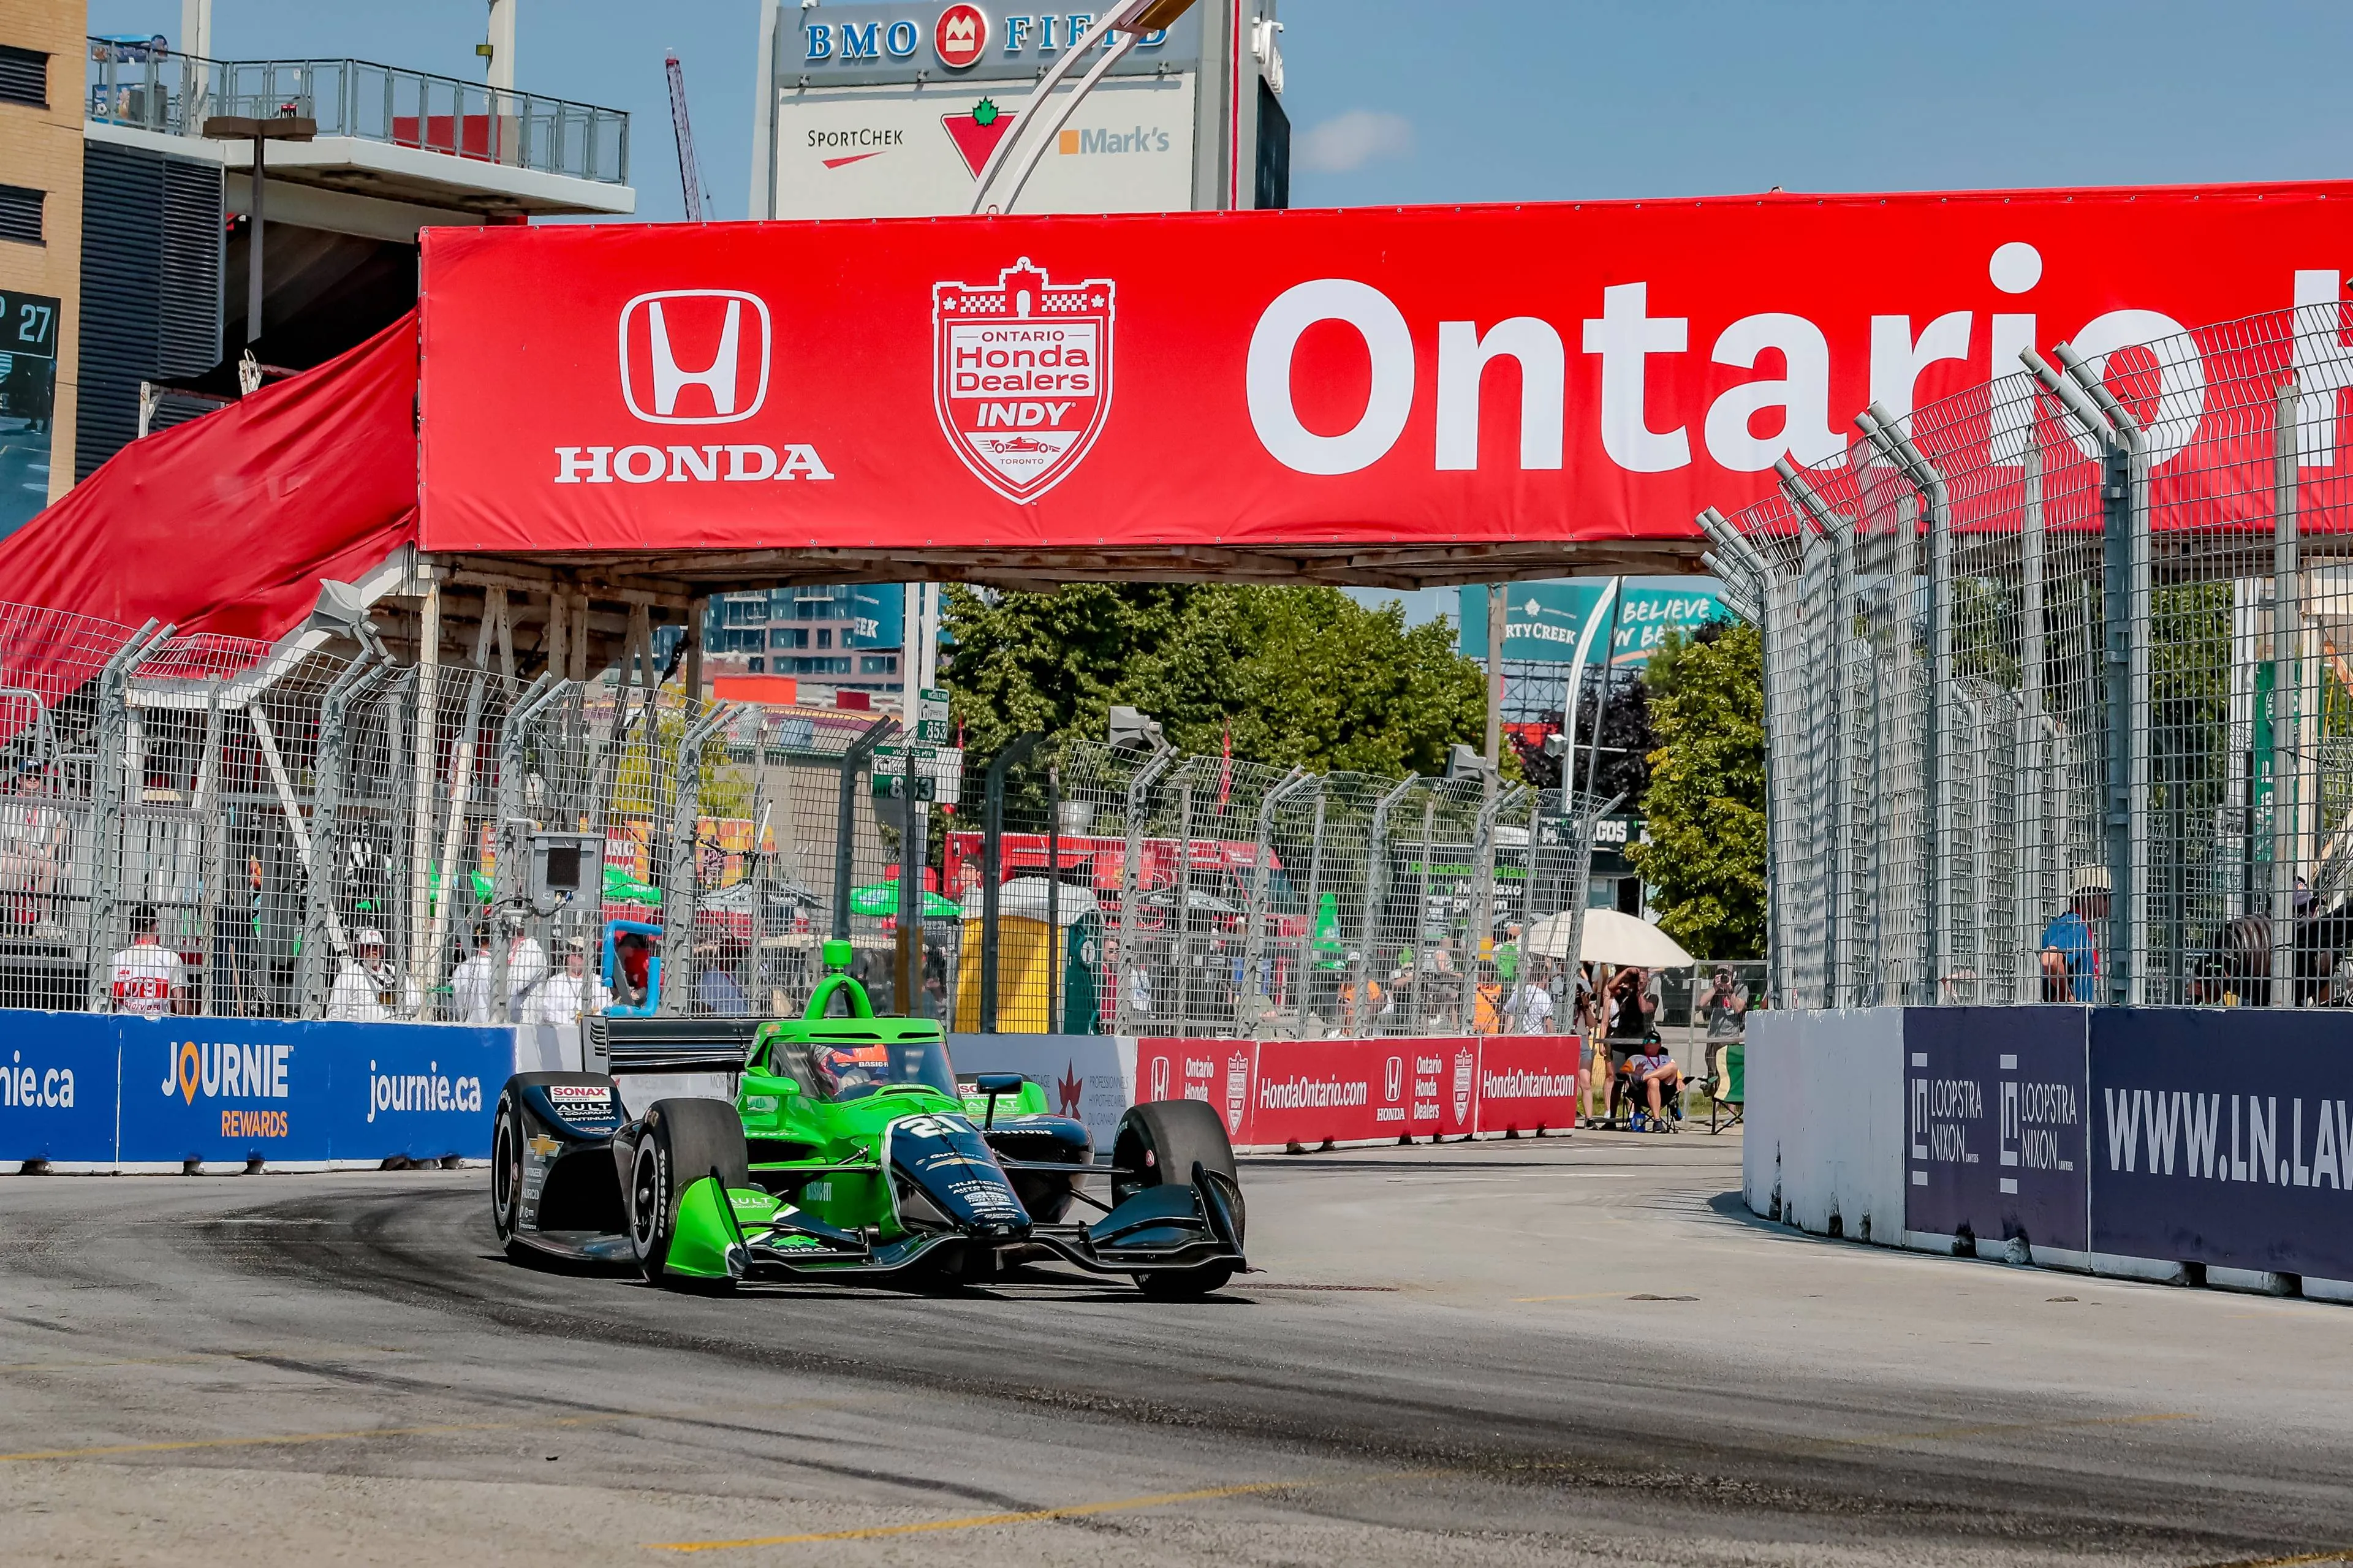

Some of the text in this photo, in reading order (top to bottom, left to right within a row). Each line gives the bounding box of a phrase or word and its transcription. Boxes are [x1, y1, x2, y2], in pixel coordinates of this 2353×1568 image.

[805, 20, 919, 59] BMO
[1080, 127, 1170, 154] Mark's
[19, 304, 51, 343] 27
[982, 330, 1065, 342] ONTARIO
[956, 344, 1089, 368] Honda
[1246, 243, 2206, 476] Ontario
[956, 369, 1090, 392] Dealers
[976, 401, 1072, 427] INDY
[554, 444, 835, 483] HONDA
[1623, 597, 1711, 624] BELIEVE
[890, 776, 934, 800] 83
[162, 1042, 289, 1106] JOURNIE
[1186, 1055, 1214, 1078] Ontario
[1416, 1053, 1442, 1075] Ontario
[367, 1059, 482, 1123] journie.ca
[553, 1088, 607, 1096] SONAX
[1260, 1074, 1366, 1110] HondaOntario.com
[1415, 1076, 1437, 1097] Honda
[1482, 1067, 1575, 1099] HondaOntario.com
[1414, 1099, 1440, 1120] Dealers
[1931, 1079, 1983, 1118] LOOPSTRA
[2021, 1082, 2077, 1125] LOOPSTRA
[221, 1110, 288, 1138] REWARDS
[899, 1115, 971, 1138] 21
[1376, 1107, 1406, 1121] HONDA
[1931, 1123, 1965, 1163] NIXON
[2021, 1129, 2058, 1170] NIXON
